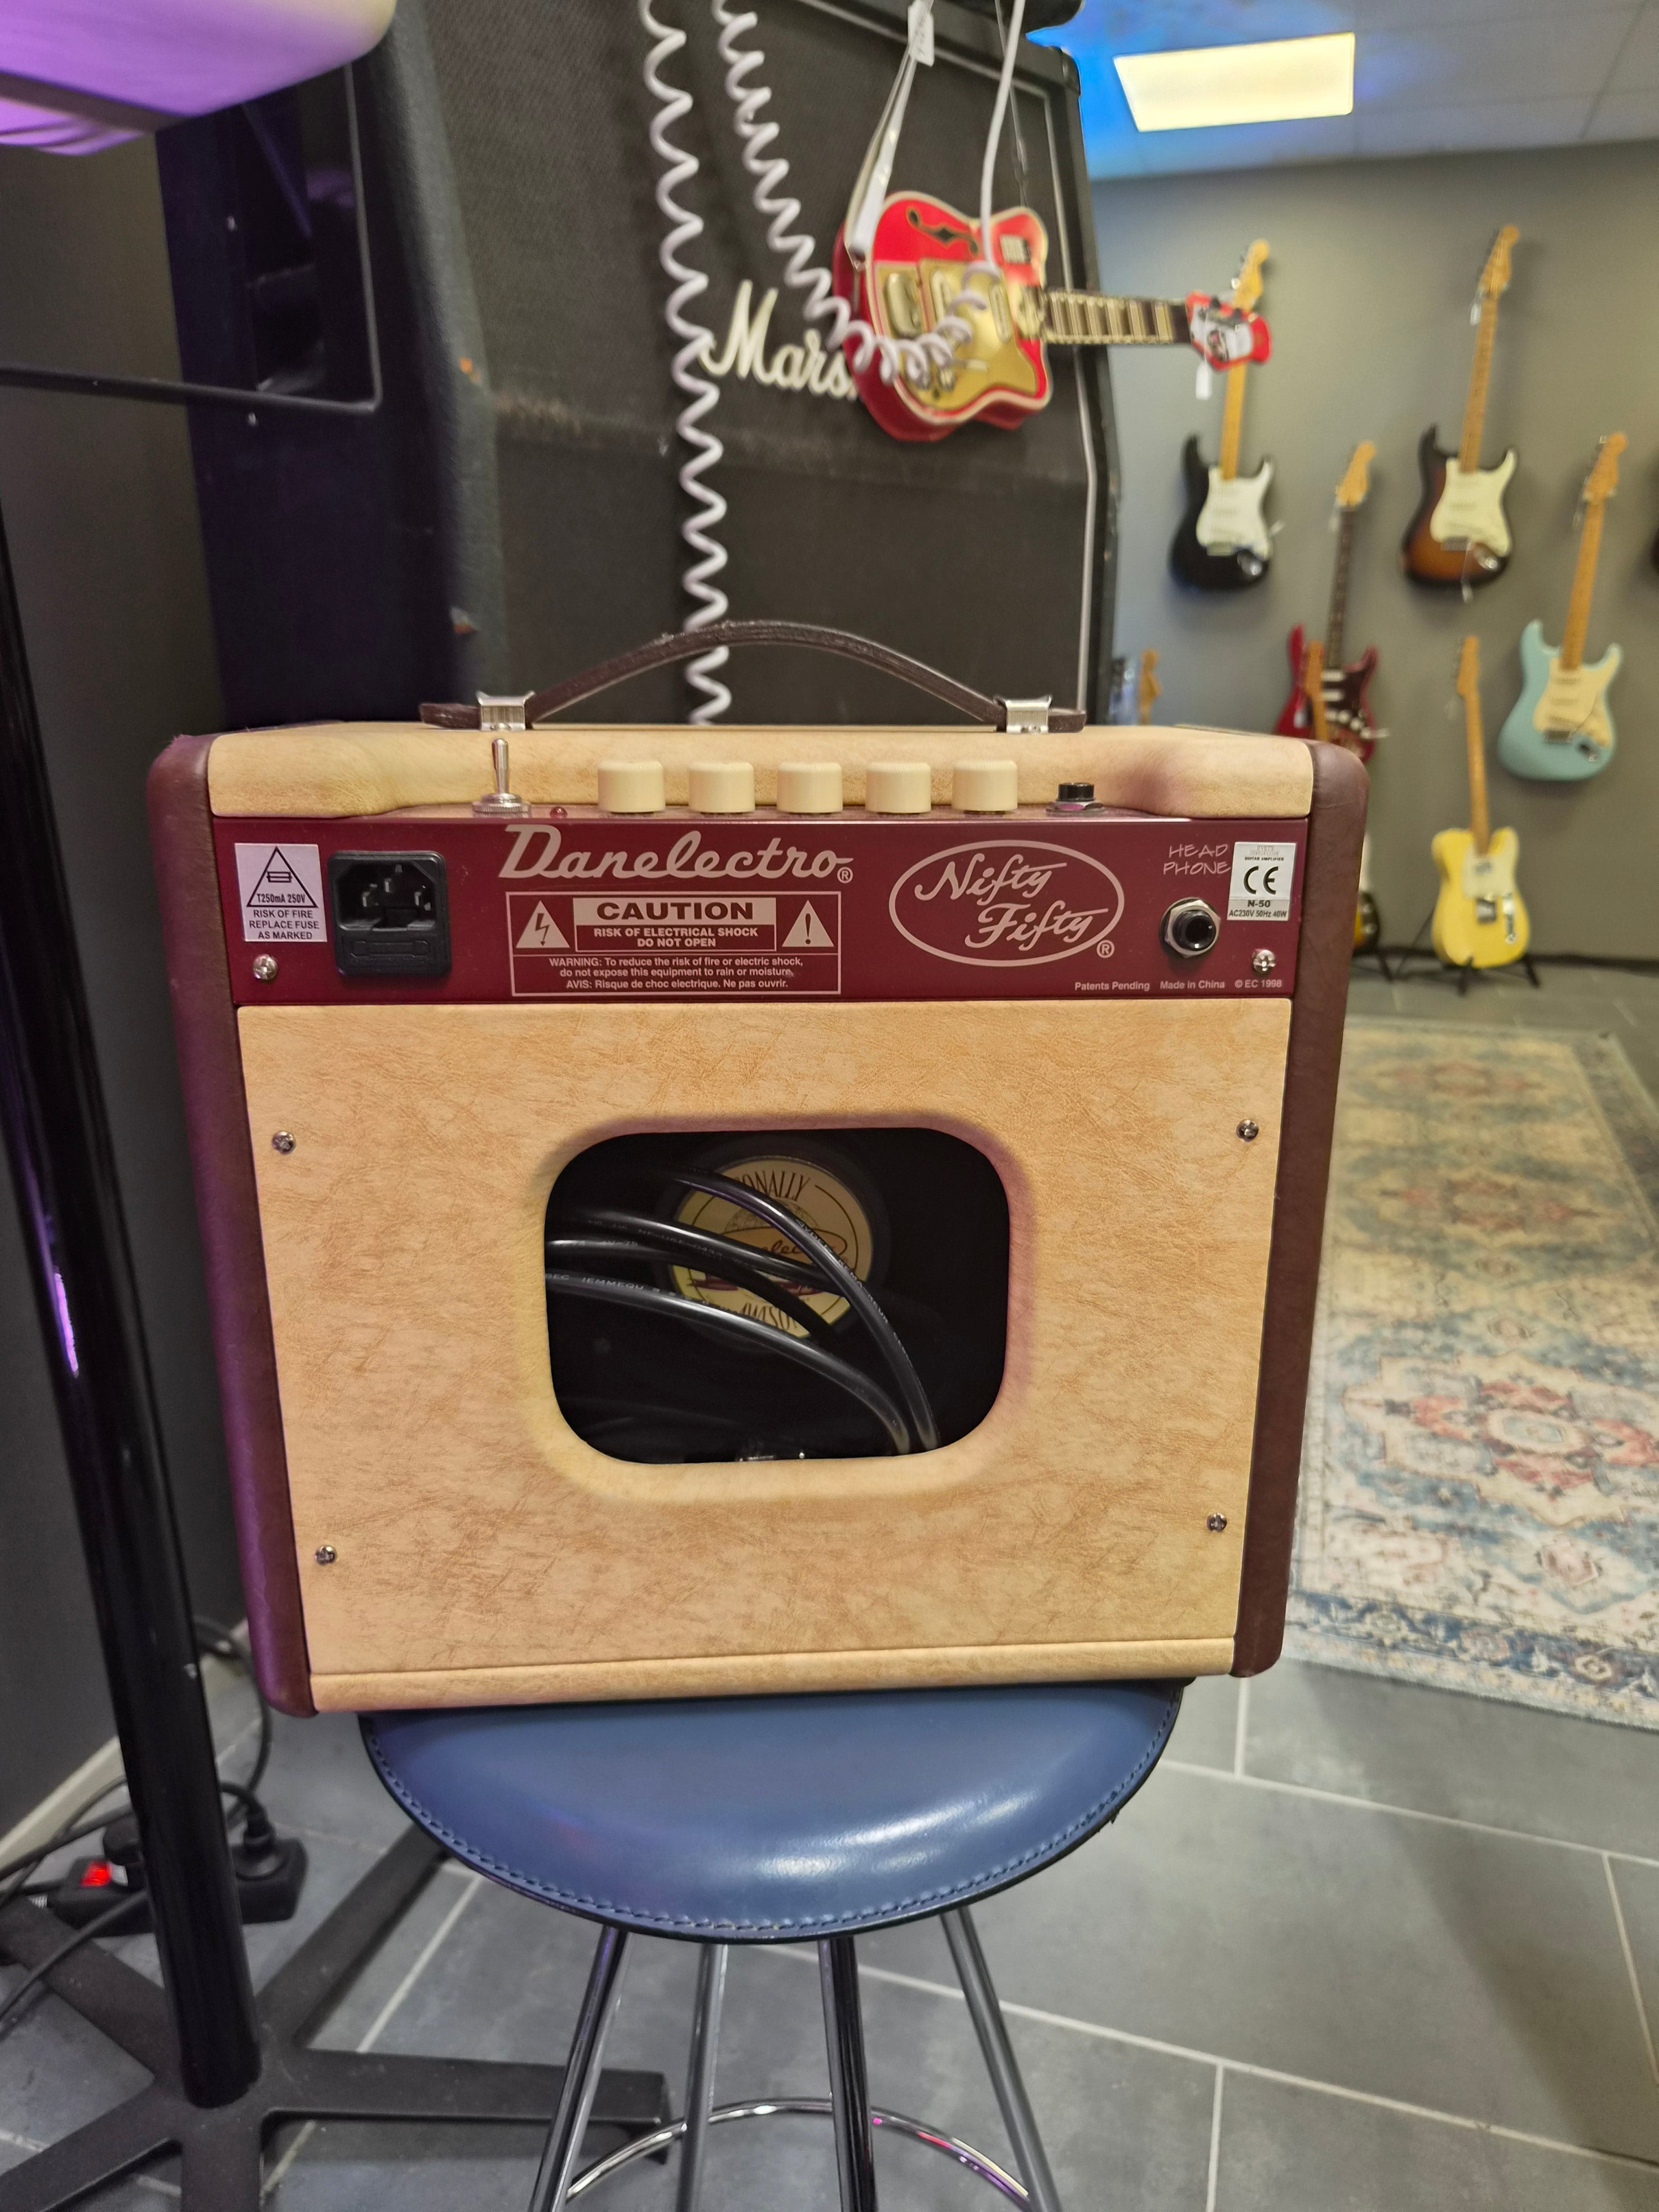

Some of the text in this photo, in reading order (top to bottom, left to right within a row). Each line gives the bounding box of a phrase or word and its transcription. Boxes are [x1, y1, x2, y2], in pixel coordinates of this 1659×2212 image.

[698, 278, 857, 400] Mars
[498, 824, 854, 878] Danelectro
[1169, 844, 1228, 858] HEAD
[1163, 861, 1231, 875] PHONE
[915, 853, 1067, 905] Nifty
[1244, 865, 1279, 895] CE
[257, 894, 306, 903] T250mA 250V
[253, 910, 275, 918] RISK
[278, 910, 290, 918] OF
[597, 902, 753, 920] CAUTION
[594, 928, 758, 937] RISK OF ELECTRICAL SHOCK
[964, 900, 1108, 951] Fifty
[638, 938, 654, 947] DO
[658, 938, 681, 947] NOT
[549, 958, 601, 966] WARNING:
[619, 957, 652, 966] reduce
[654, 957, 670, 966] the
[672, 957, 690, 966] risk
[692, 957, 702, 966] of
[704, 957, 720, 966] fire
[735, 957, 769, 966] electric
[772, 957, 803, 967] shock,
[560, 968, 572, 977] do
[593, 970, 628, 979] expose
[631, 968, 648, 976] this
[651, 968, 701, 978] equipment
[717, 967, 734, 975] rain
[567, 980, 592, 988] AVIS:
[595, 979, 629, 990] Risque
[631, 979, 643, 988] de
[645, 979, 669, 988] choc
[671, 979, 721, 989] electrique.
[739, 981, 755, 989] pas
[759, 979, 787, 987] ouvrir.
[1074, 982, 1150, 991] Patents Pending
[734, 1168, 812, 1201] ONALLY
